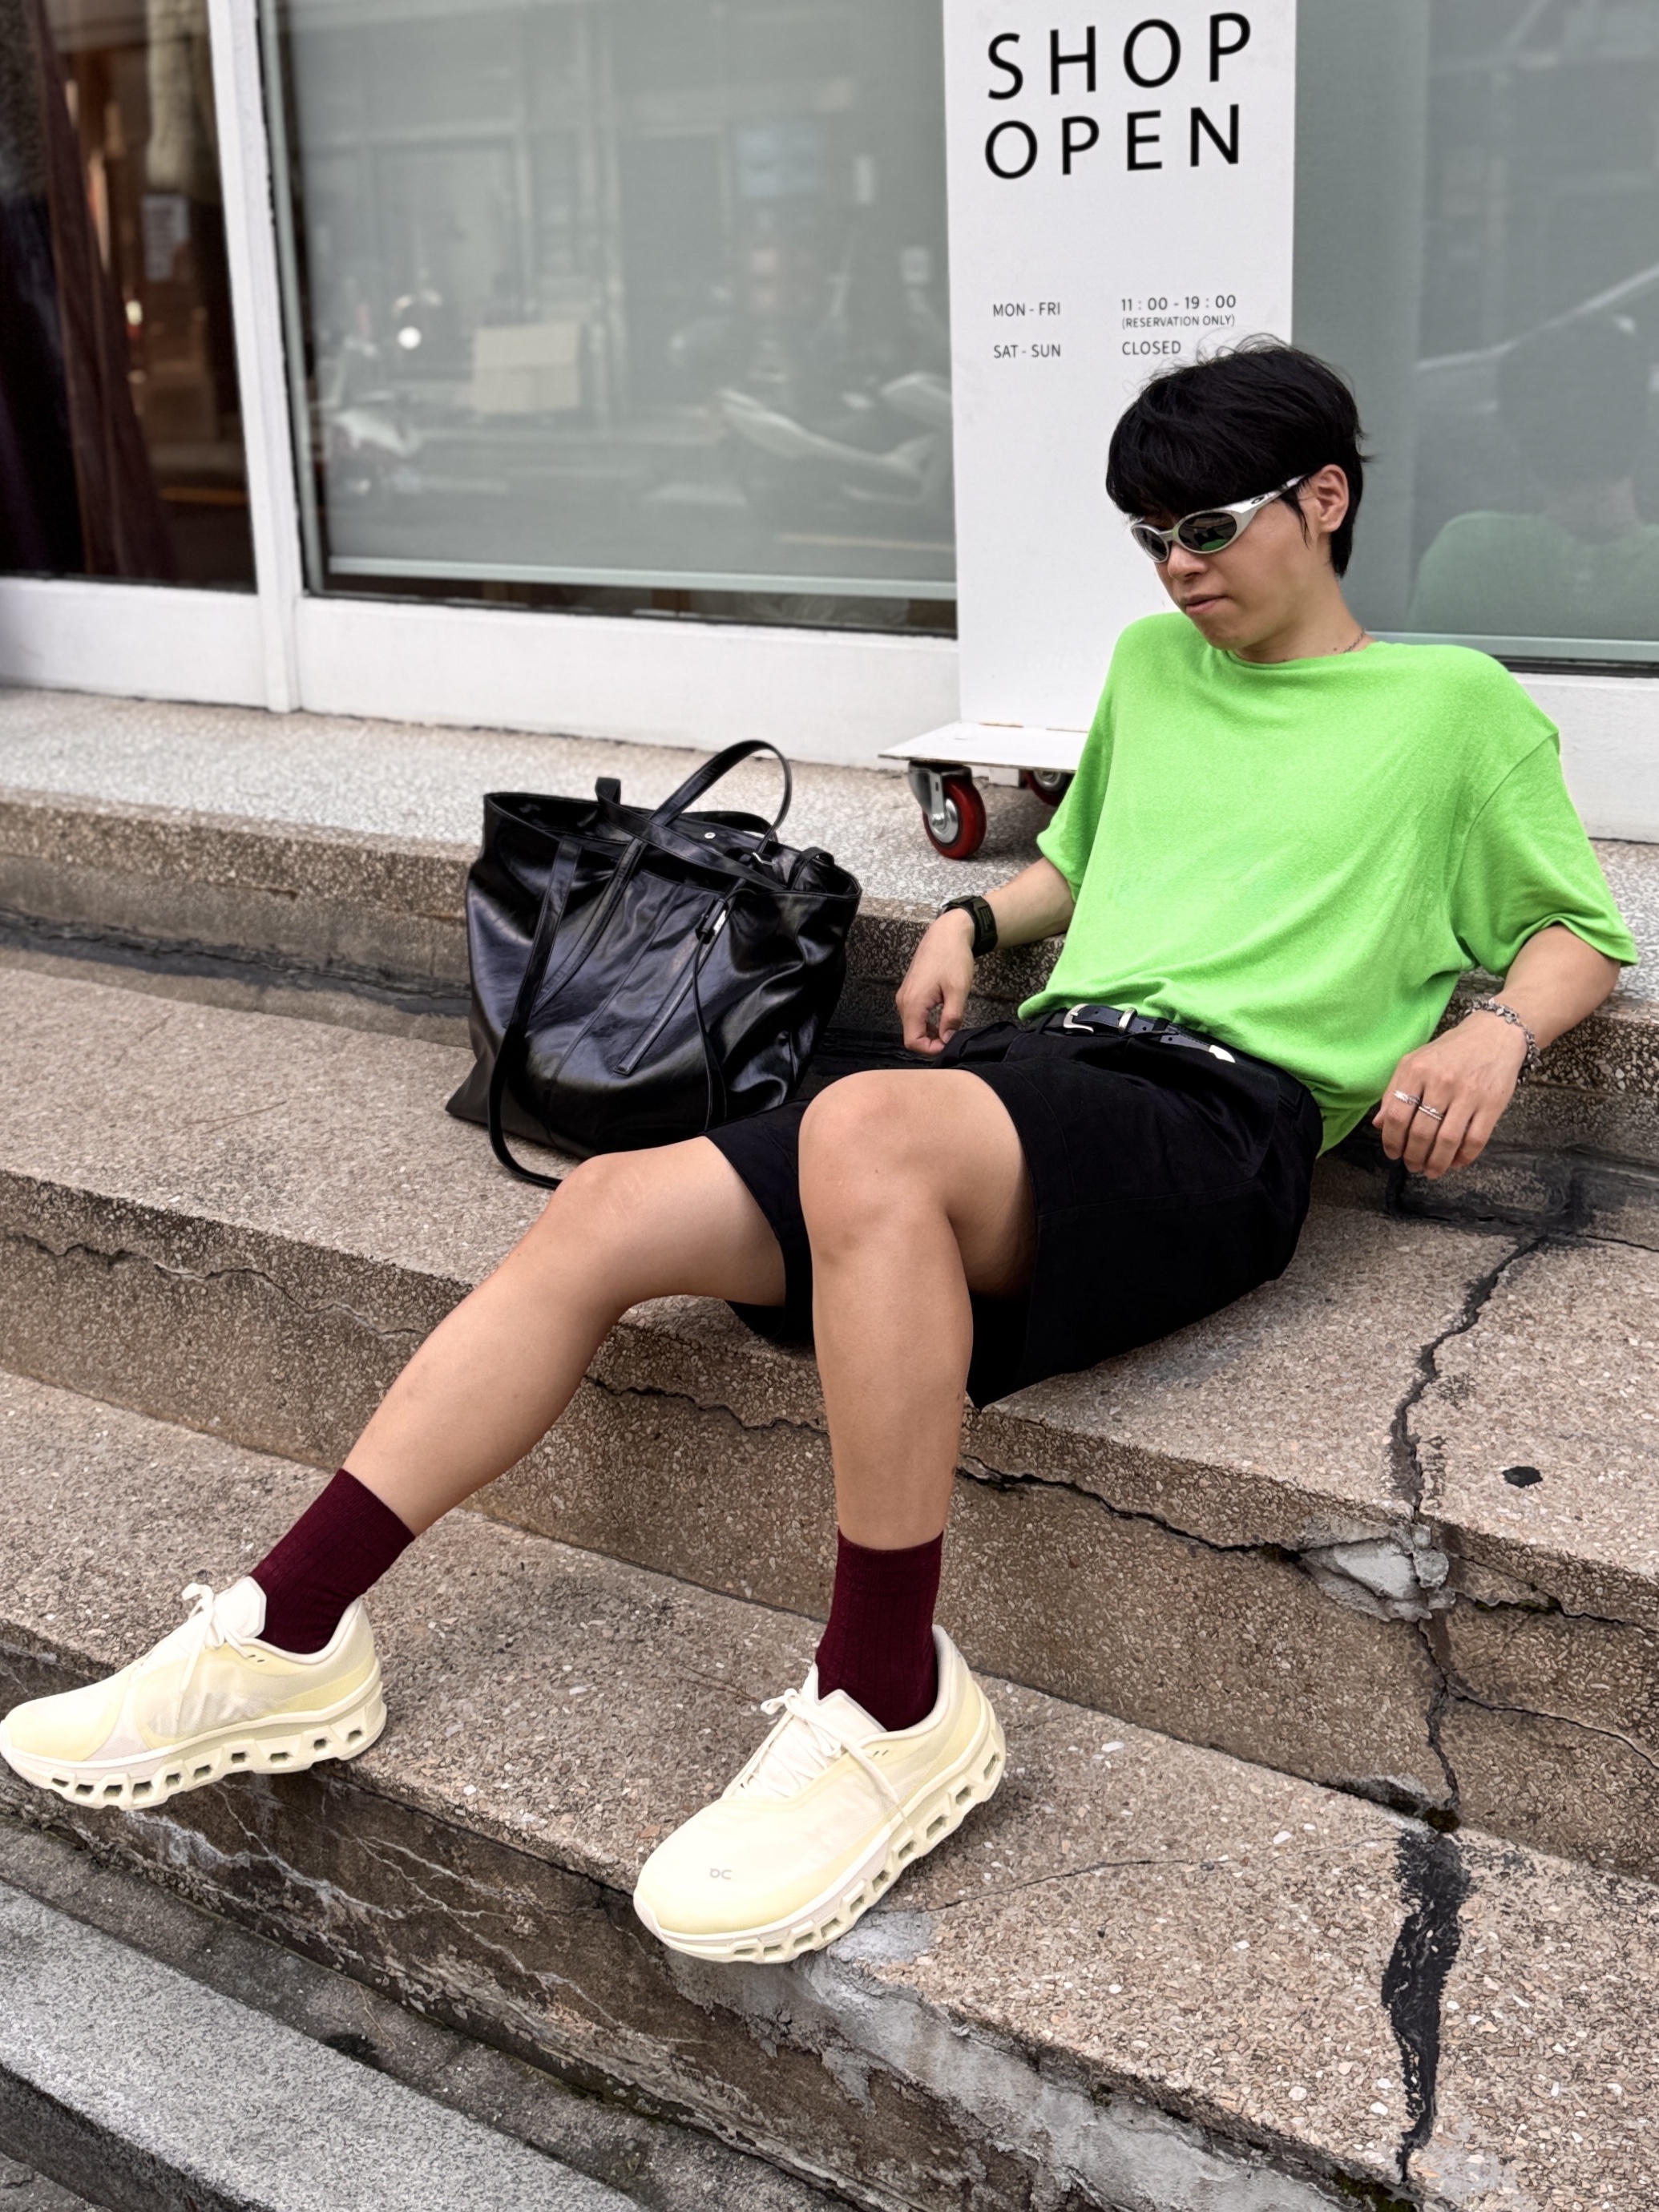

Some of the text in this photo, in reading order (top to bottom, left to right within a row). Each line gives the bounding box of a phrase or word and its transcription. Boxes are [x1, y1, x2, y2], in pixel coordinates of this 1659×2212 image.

[987, 12, 1251, 100] SHOP
[984, 103, 1239, 180] OPEN
[1121, 313, 1235, 331] (RESERVATION ONLY)
[1121, 340, 1181, 356] CLOSED
